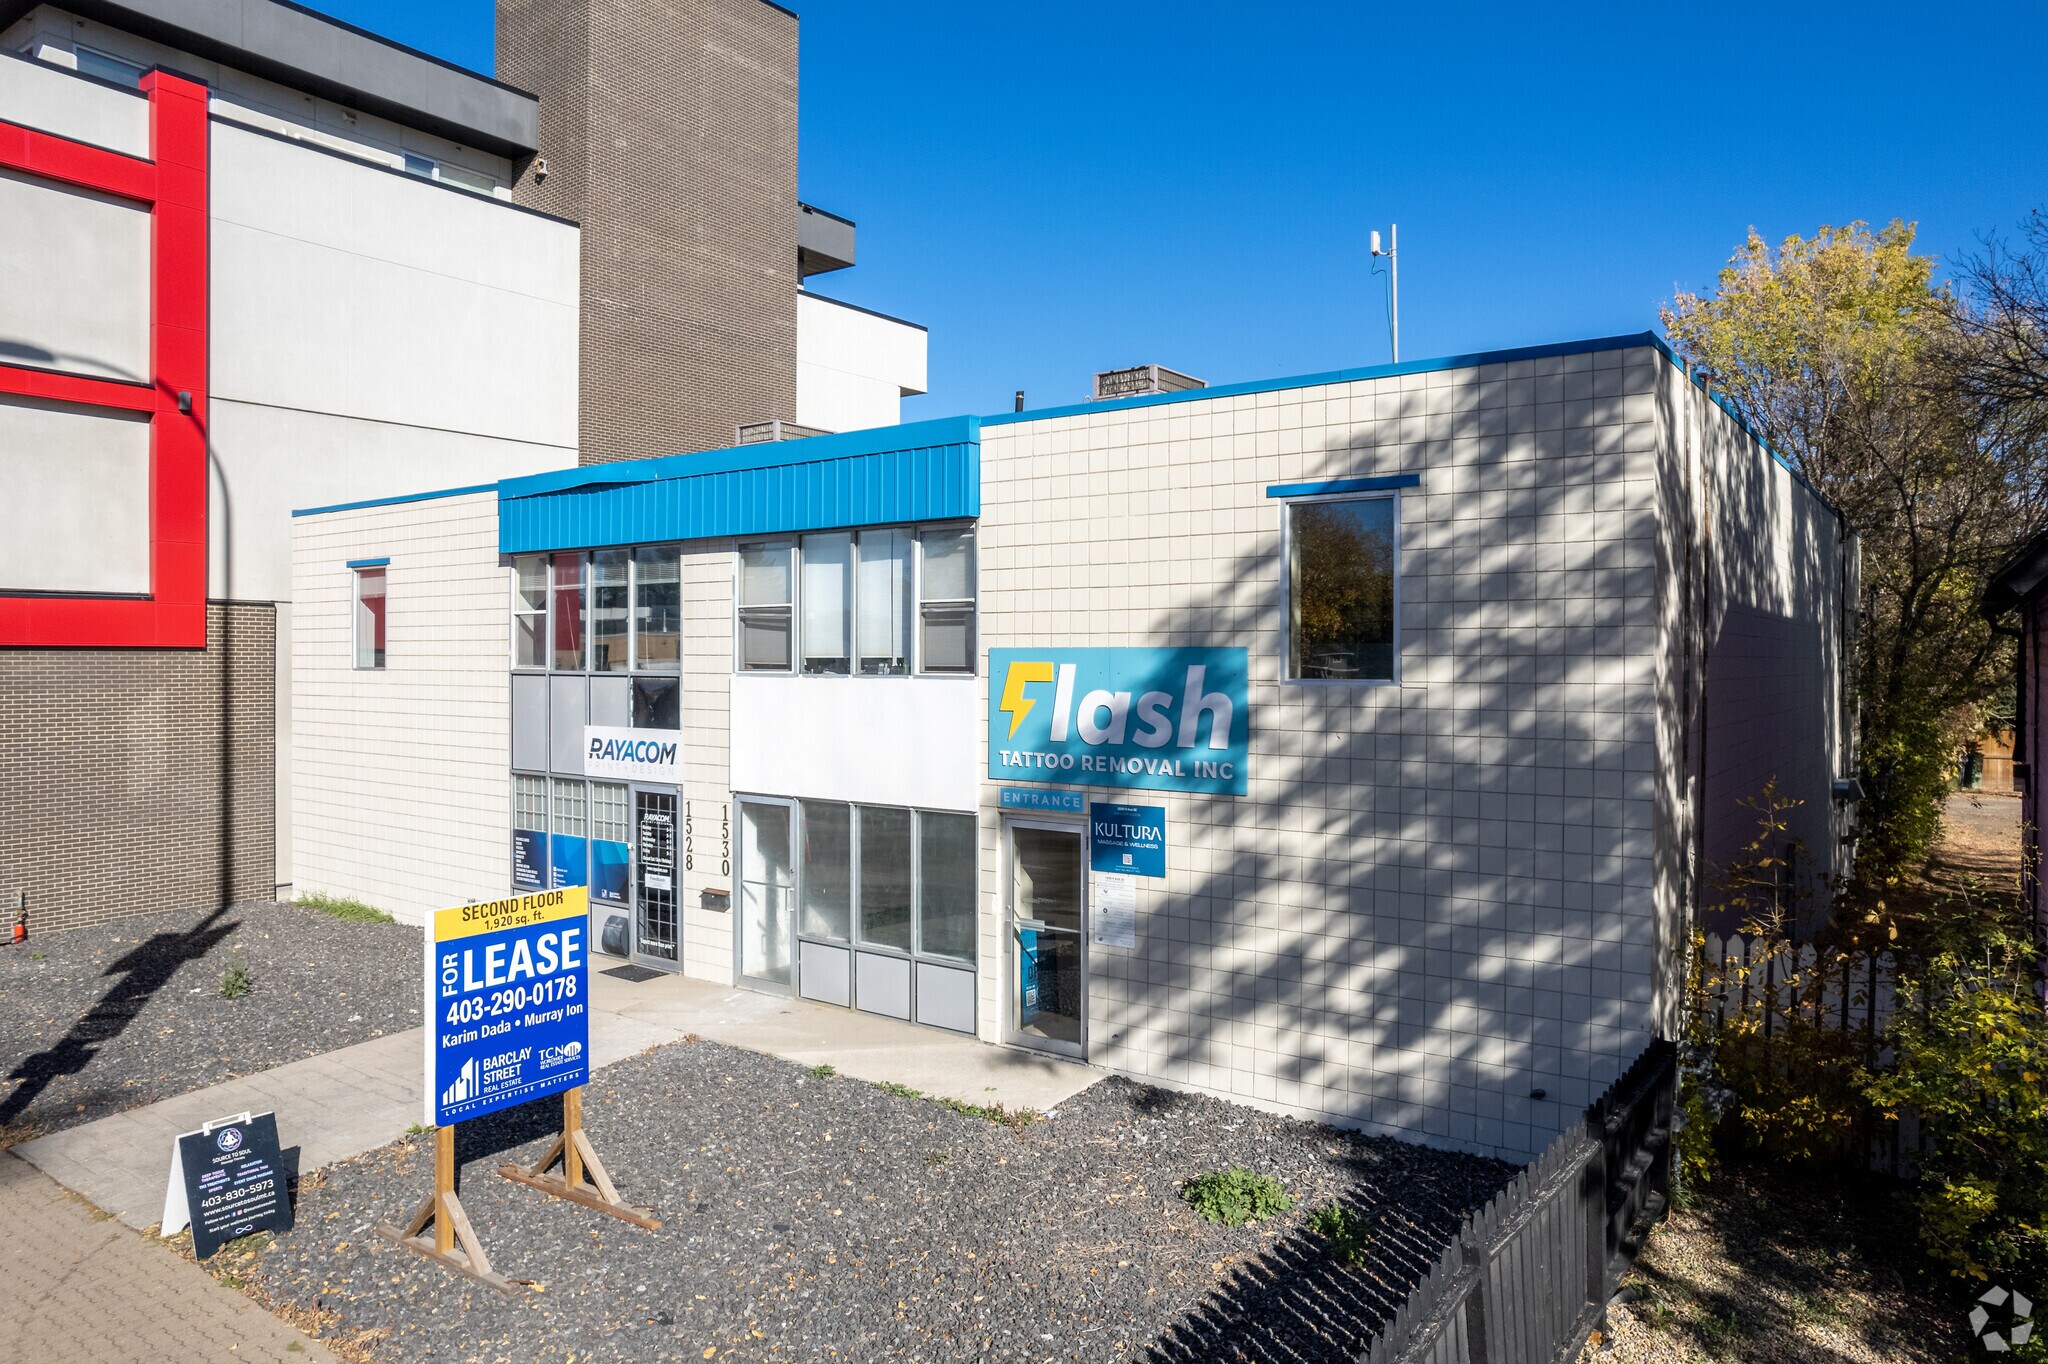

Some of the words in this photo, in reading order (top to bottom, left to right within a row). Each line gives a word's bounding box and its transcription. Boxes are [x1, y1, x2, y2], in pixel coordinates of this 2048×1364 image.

[1000, 661, 1233, 749] Flash
[589, 738, 677, 765] RAYACOM
[588, 761, 620, 769] PRINT
[633, 765, 673, 776] DESIGN
[1000, 750, 1074, 770] TATTOO
[1081, 755, 1186, 777] REMOVAL
[1194, 760, 1234, 780] INC
[1003, 792, 1081, 808] ENTRANCE
[644, 813, 670, 822] RAYACOM
[722, 804, 730, 876] 1530
[1095, 822, 1162, 842] KULTURA
[463, 898, 518, 922] SECOND
[524, 890, 564, 910] FLOOR
[485, 916, 512, 930] 1,920
[516, 916, 530, 925] sq.
[533, 910, 544, 920] ft.
[464, 928, 581, 992] LEASE
[442, 953, 458, 997] FOR
[446, 975, 577, 1026] 403-290-0178
[442, 1030, 478, 1048] Karim
[482, 1020, 511, 1038] Dada
[525, 1008, 563, 1027] Murray
[567, 1003, 583, 1016] Ion
[483, 1046, 532, 1071] BARCLAY
[539, 1045, 564, 1060] TCN
[483, 1064, 521, 1084] STREET
[484, 1083, 499, 1094] REAL
[501, 1077, 522, 1089] ESTATE
[446, 1104, 476, 1117] LOCAL
[483, 1086, 534, 1105] EXPERTISE
[541, 1073, 579, 1088] MATTERS
[212, 1153, 231, 1164] SOURCE
[239, 1148, 252, 1156] SOUL
[202, 1179, 274, 1208] 403-830-5973
[230, 1217, 248, 1226] wellness
